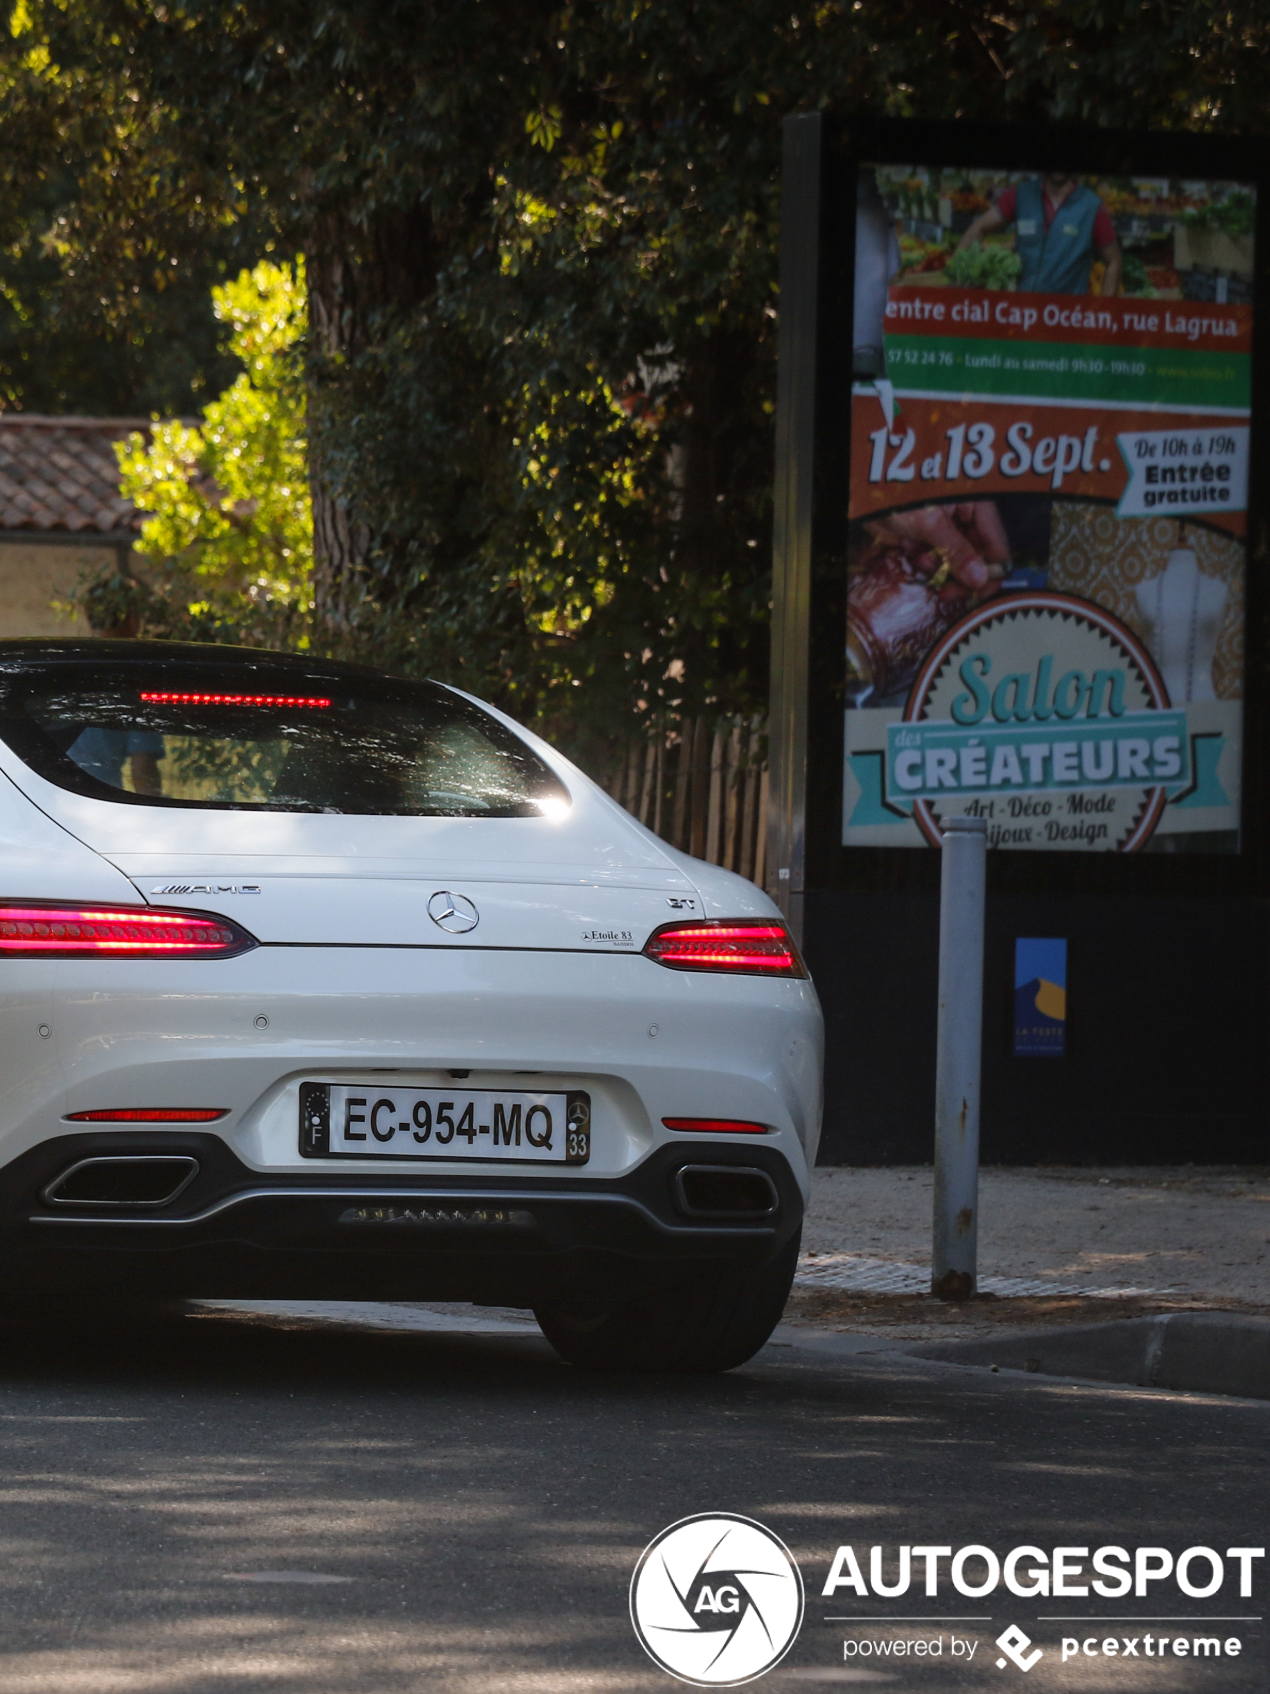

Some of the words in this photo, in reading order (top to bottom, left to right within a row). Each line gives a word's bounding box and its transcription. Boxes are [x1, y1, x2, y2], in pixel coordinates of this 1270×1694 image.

[951, 298, 989, 322] cial
[995, 302, 1037, 331] Cap
[1043, 304, 1117, 333] Océan,
[1123, 311, 1159, 332] rue
[1165, 311, 1238, 341] Lagrua
[938, 350, 953, 366] 76
[965, 353, 1002, 368] Lundi
[1003, 357, 1020, 369] au
[1022, 357, 1068, 372] samedi
[869, 425, 916, 482] 12
[945, 422, 995, 480] 13
[999, 421, 1111, 489] Sept.
[1134, 437, 1156, 458] De
[1162, 437, 1188, 457] 10h
[1192, 436, 1203, 455] à
[1208, 435, 1235, 455] 19h
[1145, 462, 1230, 484] Entrée
[1143, 486, 1230, 507] gratuite
[951, 653, 1126, 726] Salon
[895, 729, 921, 747] des
[894, 736, 1181, 791] CRÉATEURS
[964, 798, 994, 818] Art
[1008, 795, 1052, 818] Déco
[1067, 793, 1116, 815] Mode
[985, 824, 1032, 848] ijoux
[1045, 820, 1108, 846] Design
[665, 898, 695, 910] GT
[591, 930, 619, 940] Etoile
[621, 930, 632, 940] 83
[312, 1126, 322, 1145] F
[343, 1097, 553, 1151] EC-954-MQ
[569, 1133, 587, 1156] 33
